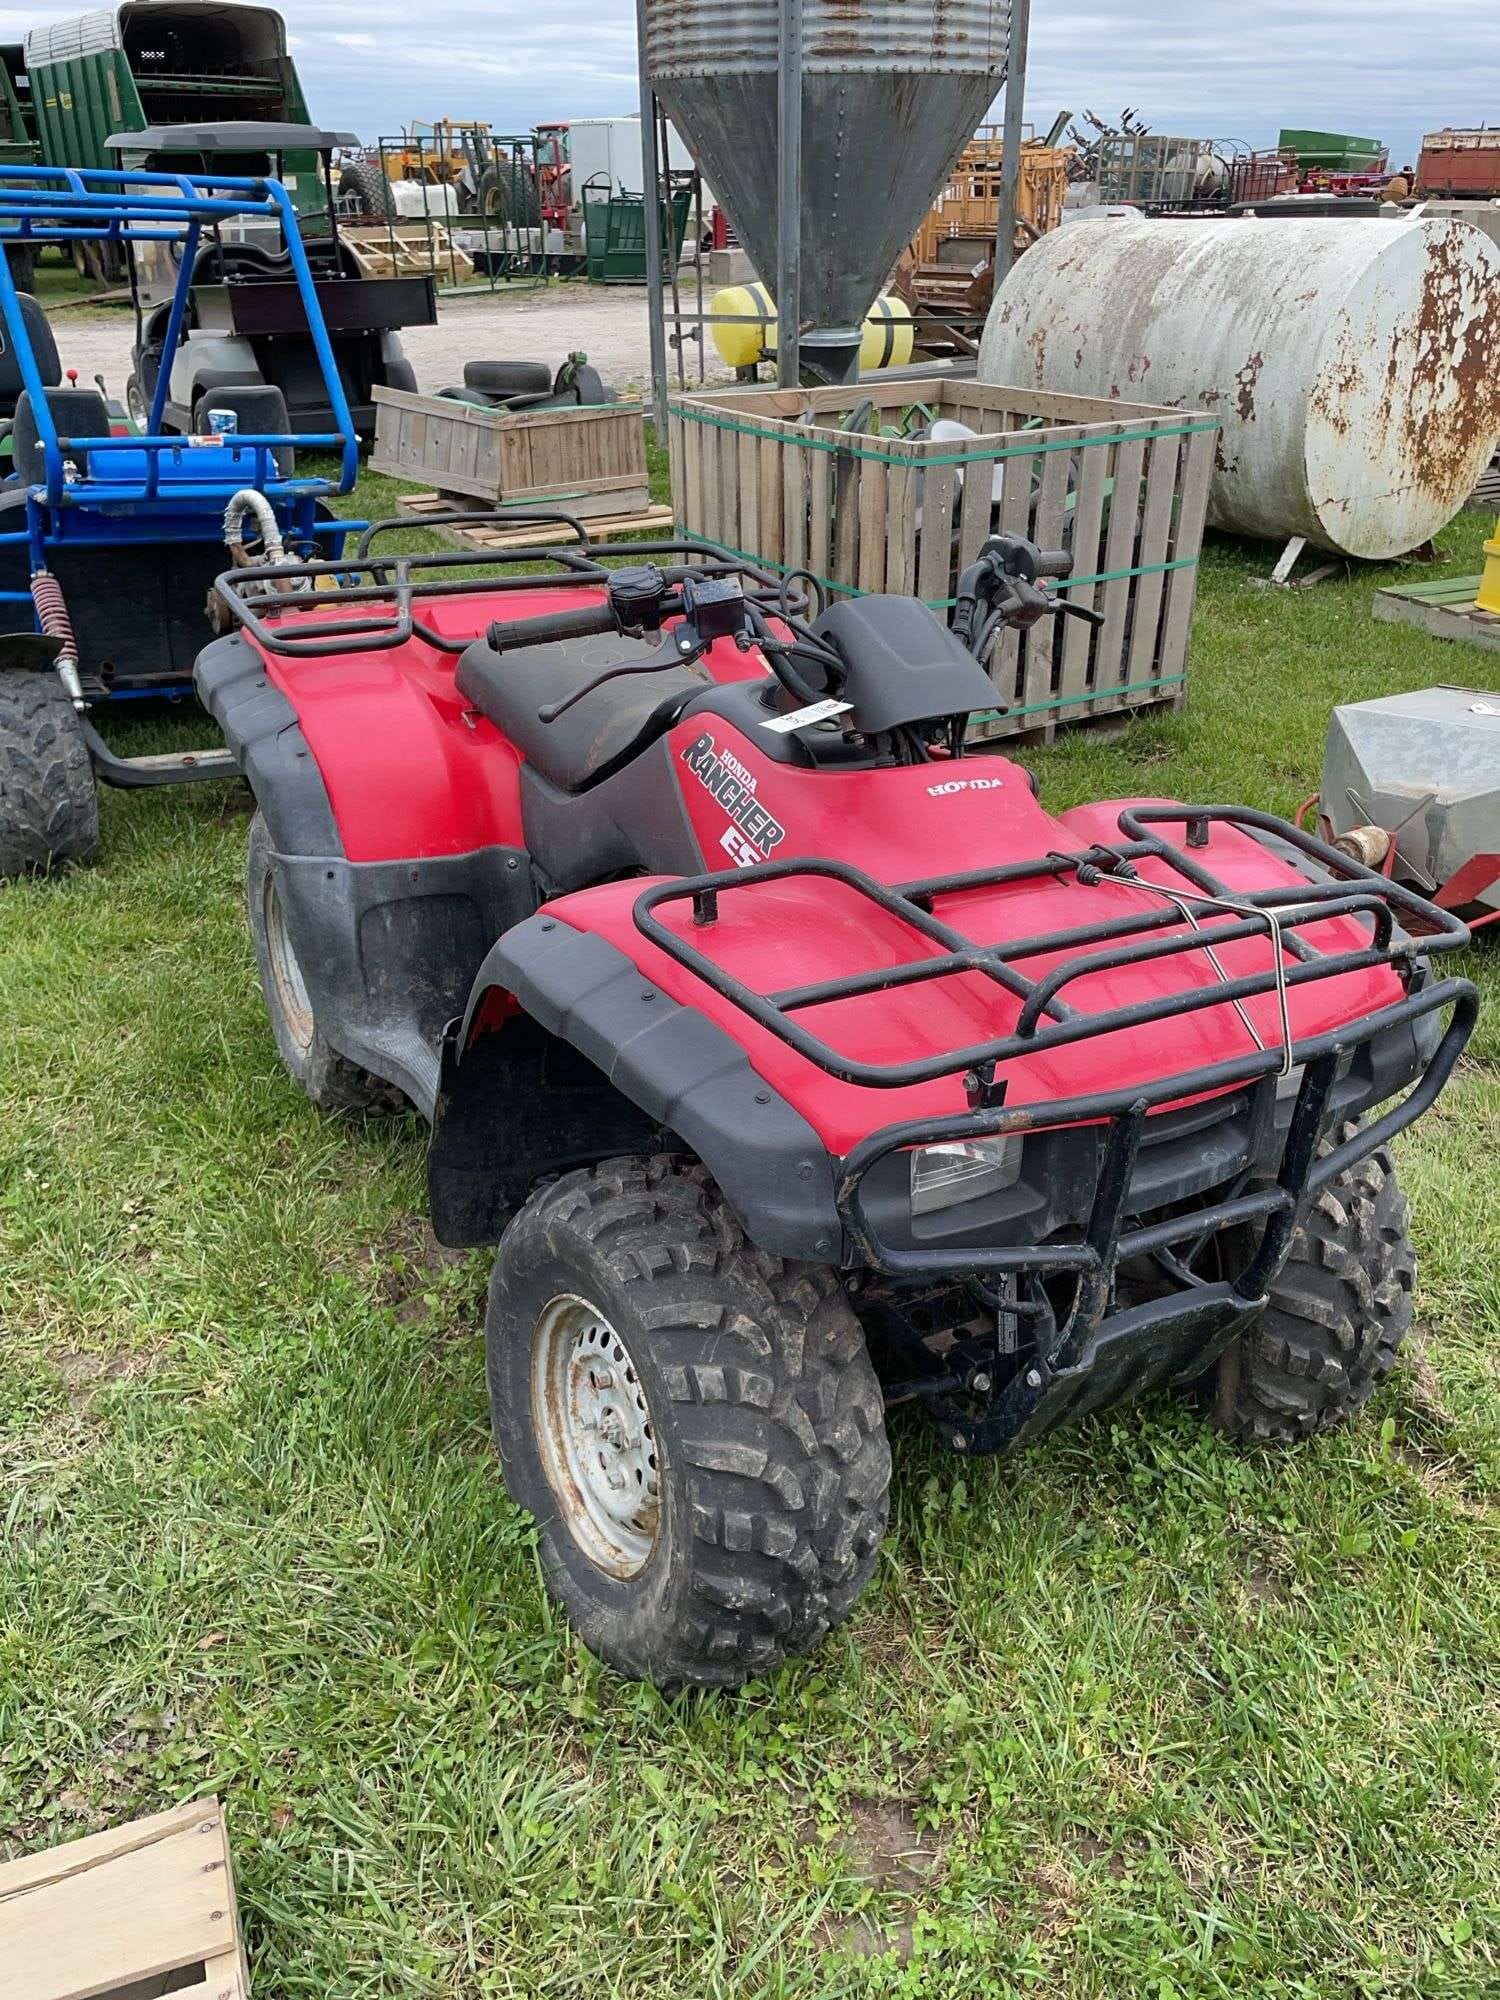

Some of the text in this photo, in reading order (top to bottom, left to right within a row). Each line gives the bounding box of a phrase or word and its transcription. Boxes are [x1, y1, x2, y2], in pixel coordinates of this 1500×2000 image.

[720, 748, 757, 795] HONDA
[680, 732, 785, 859] RANCHER
[720, 825, 763, 868] ES
